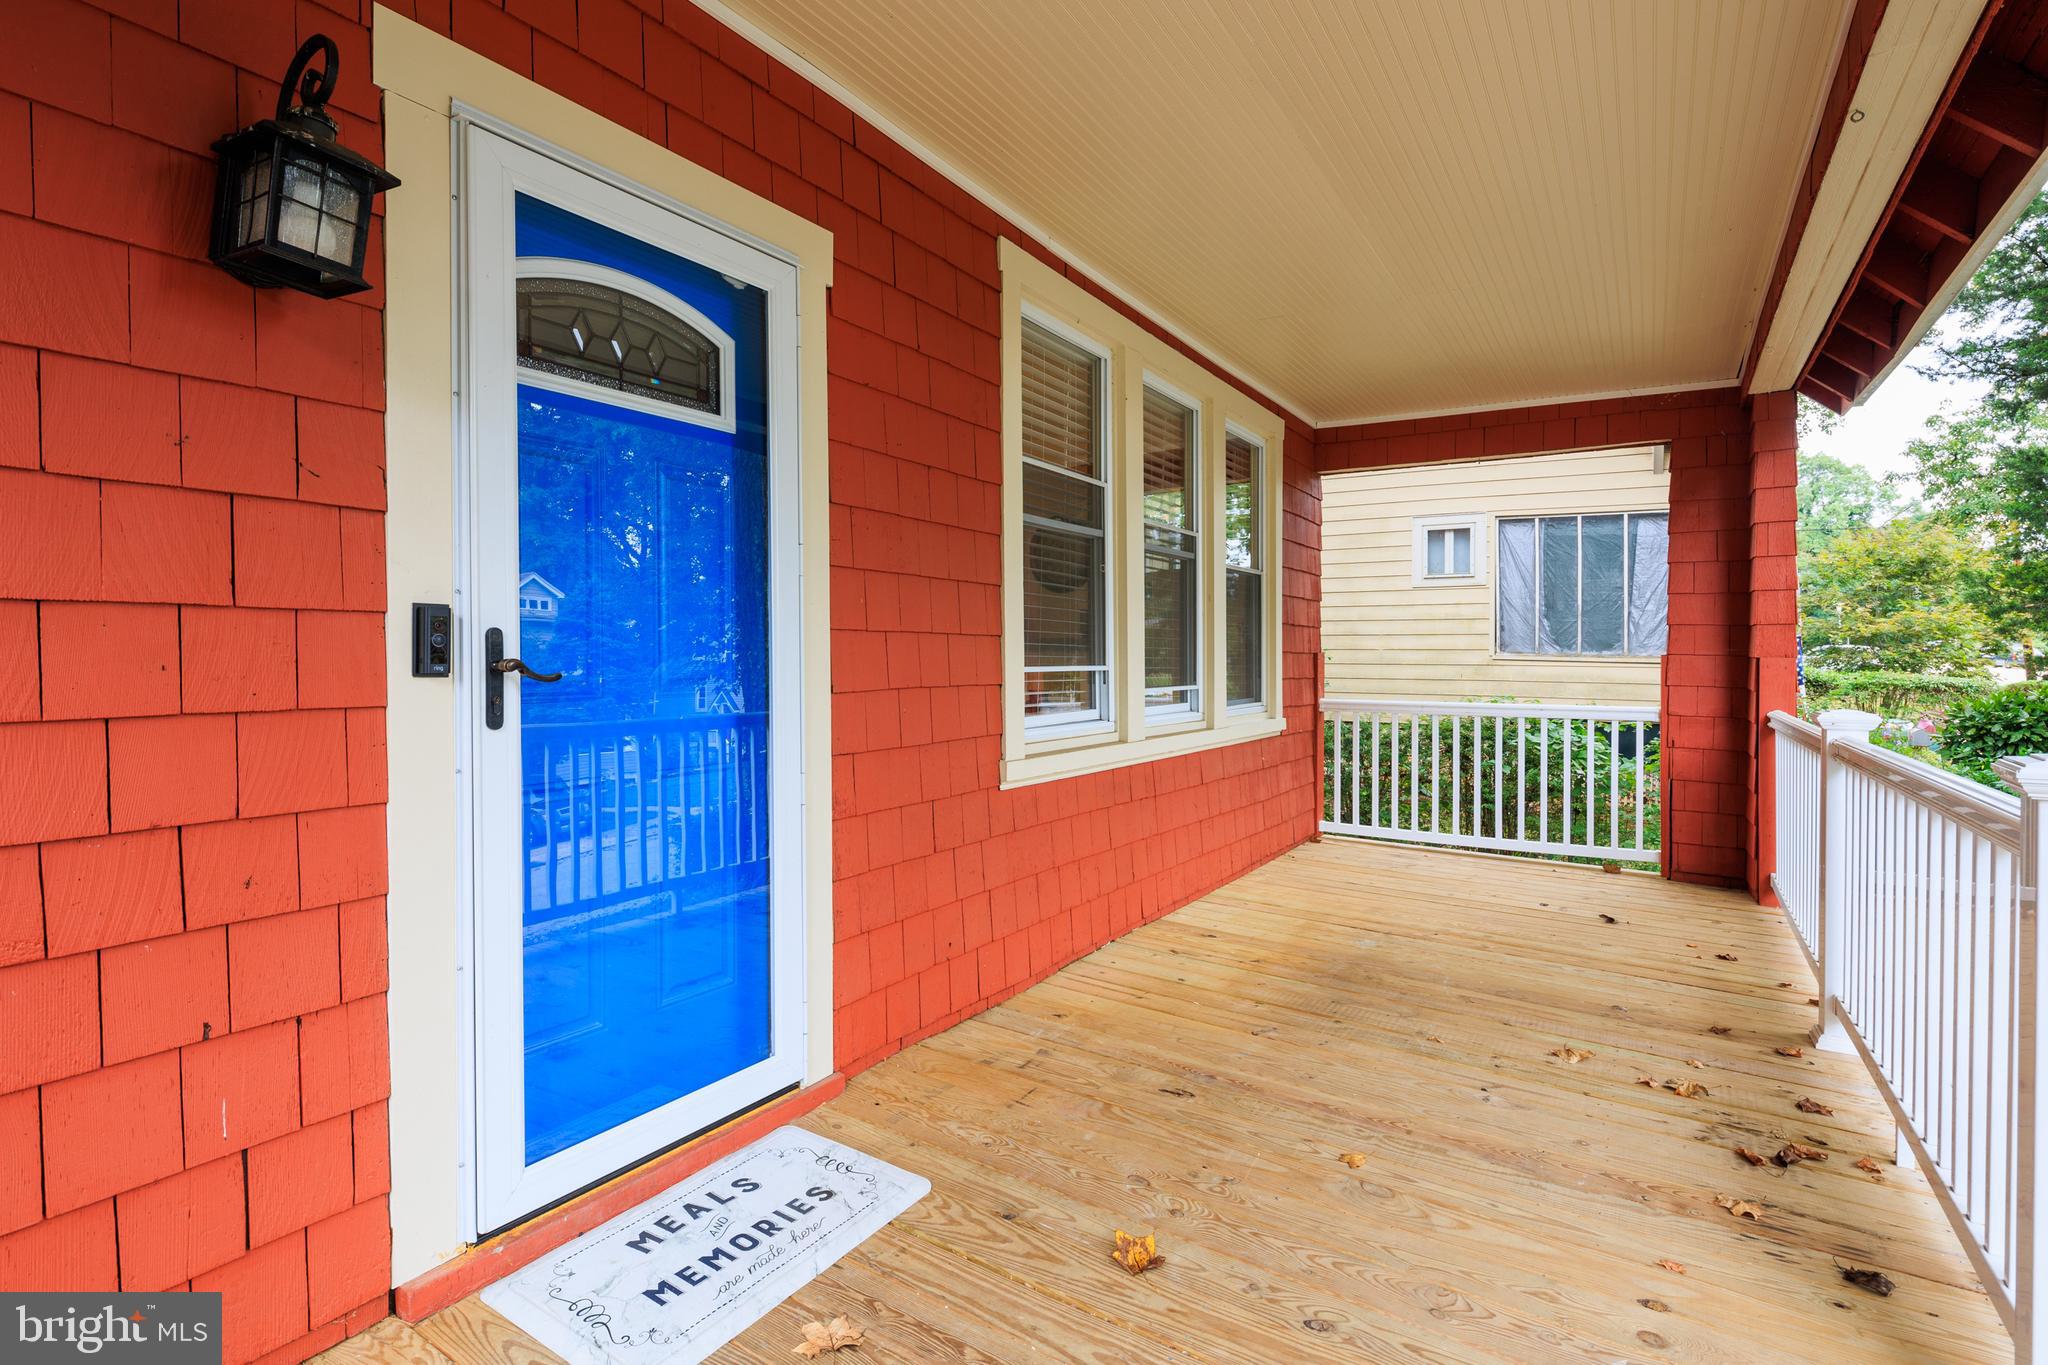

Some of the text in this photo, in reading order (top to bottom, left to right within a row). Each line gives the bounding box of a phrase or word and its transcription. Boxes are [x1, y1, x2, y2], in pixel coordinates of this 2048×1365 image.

[433, 665, 444, 673] ring
[625, 1176, 763, 1255] MEALS
[641, 1185, 836, 1307] MEMORIES
[709, 1215, 730, 1239] AND
[713, 1217, 827, 1301] are made here
